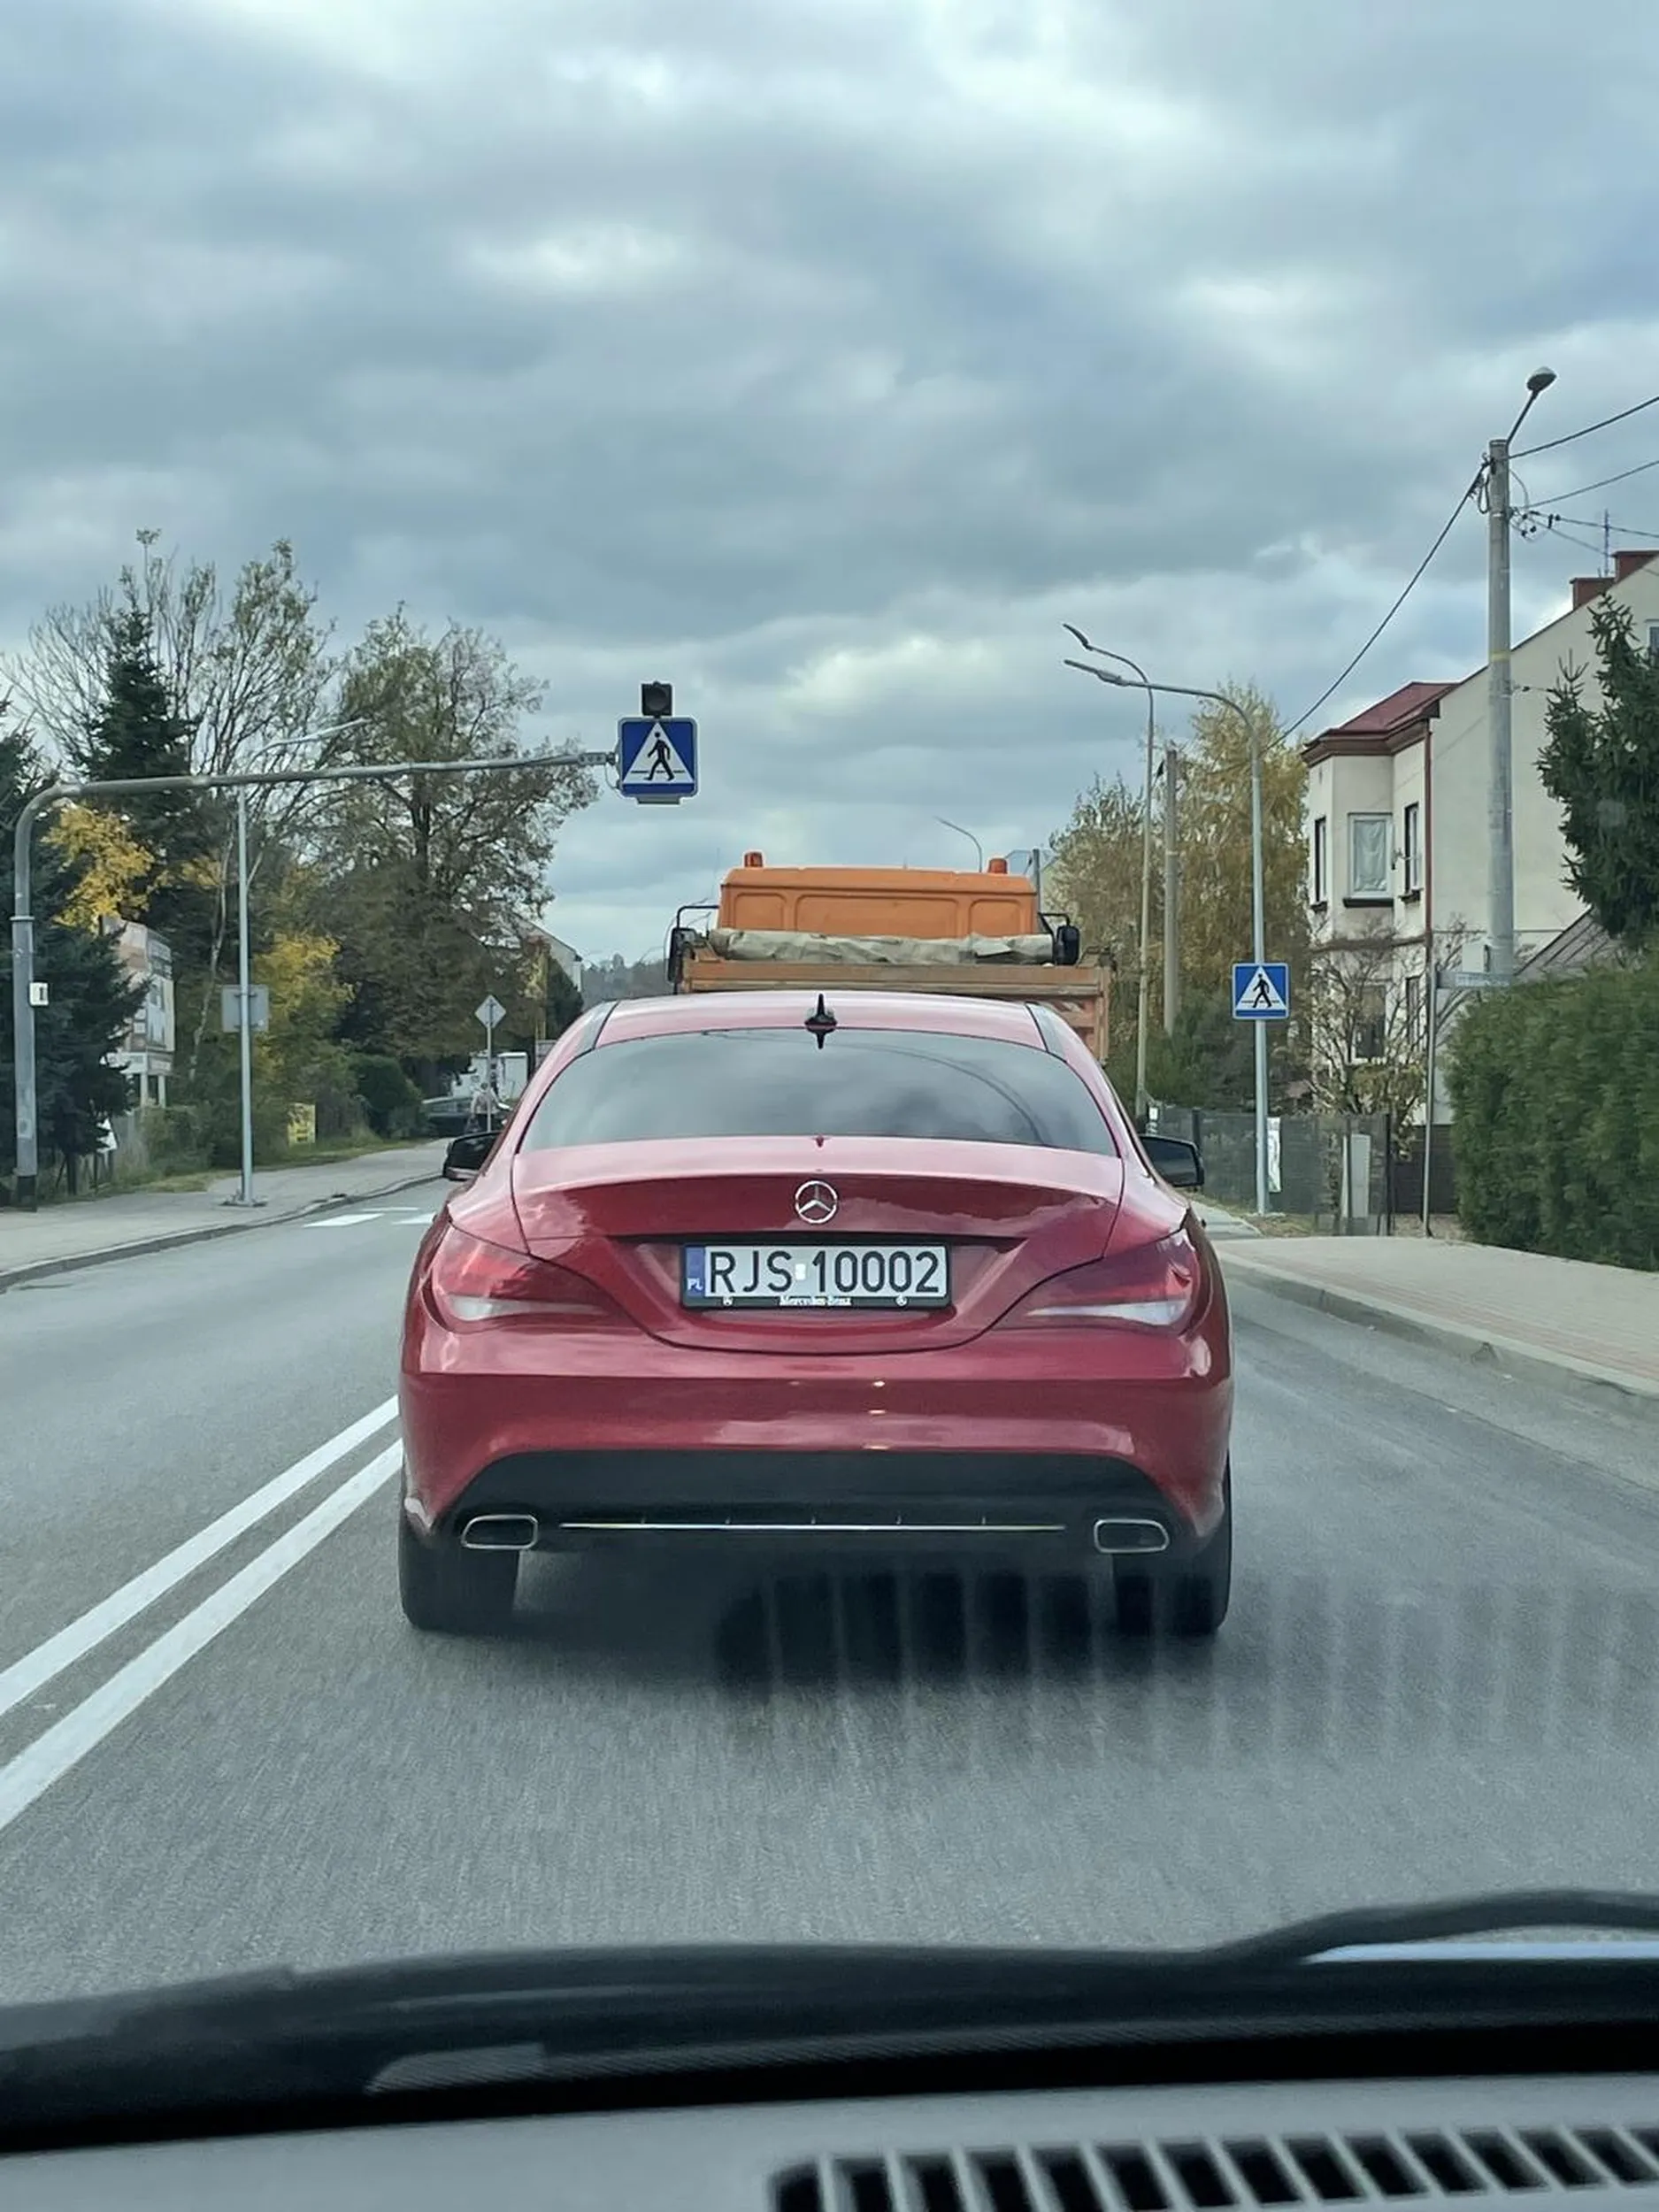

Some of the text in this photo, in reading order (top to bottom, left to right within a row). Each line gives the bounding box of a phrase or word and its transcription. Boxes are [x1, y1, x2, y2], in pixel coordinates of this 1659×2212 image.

[687, 1278, 704, 1291] PL
[710, 1250, 940, 1294] RJS 10002
